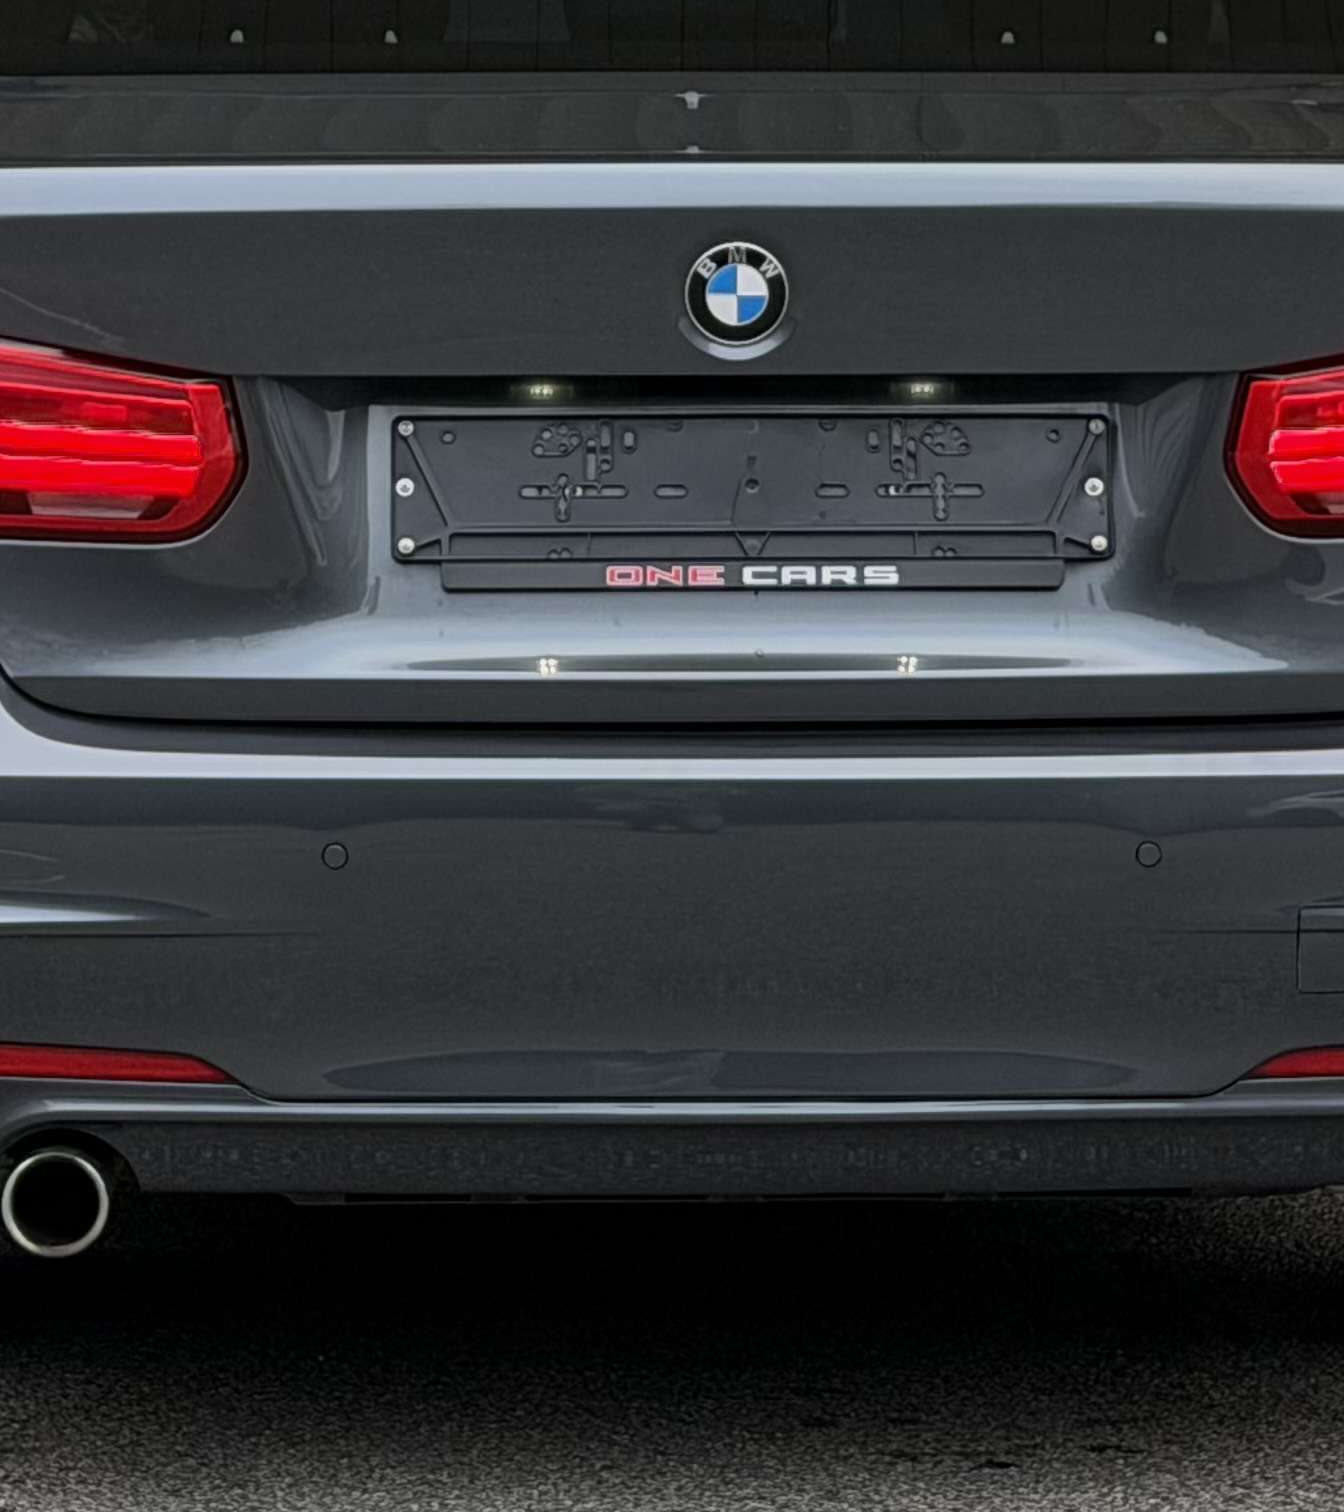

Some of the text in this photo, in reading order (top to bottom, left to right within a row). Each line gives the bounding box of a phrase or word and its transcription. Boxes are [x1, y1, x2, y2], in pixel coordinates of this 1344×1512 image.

[695, 245, 781, 280] BMW
[605, 565, 900, 586] ONE CARS
